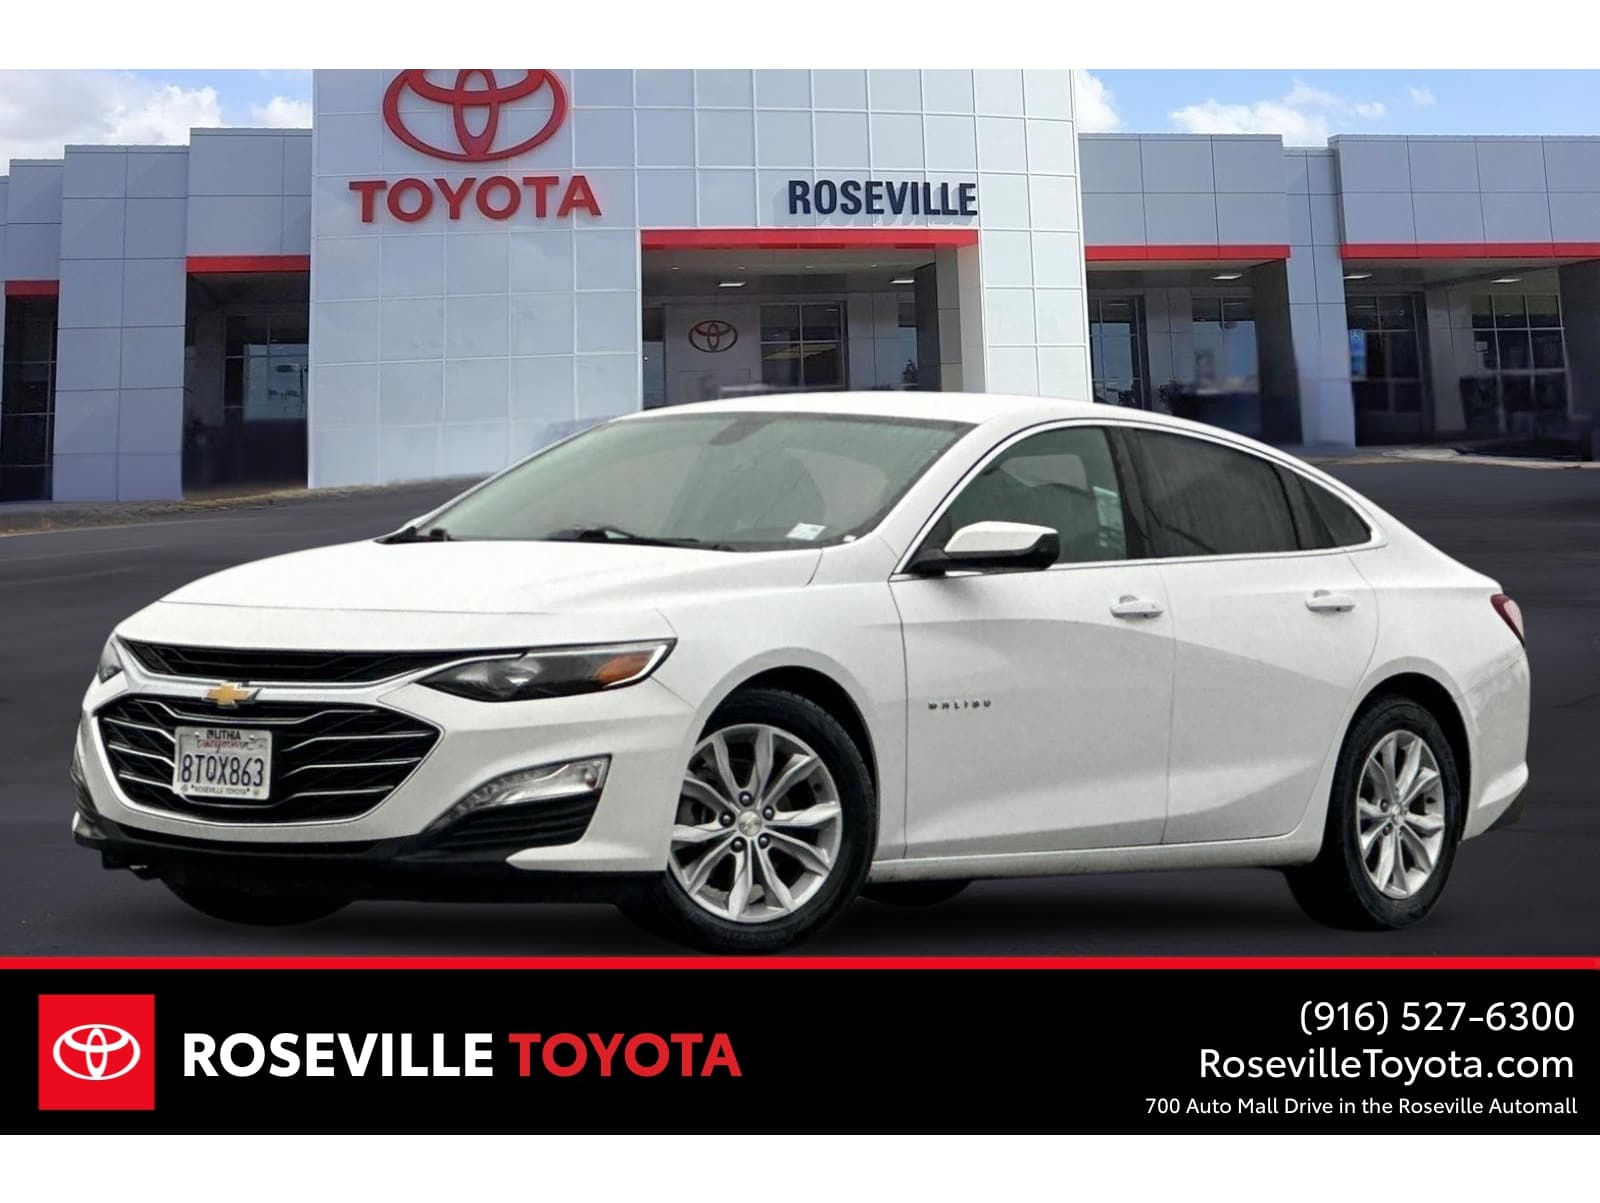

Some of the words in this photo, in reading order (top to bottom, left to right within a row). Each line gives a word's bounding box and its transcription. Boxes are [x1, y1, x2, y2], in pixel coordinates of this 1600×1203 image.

[349, 175, 602, 223] TOYOTA
[788, 179, 978, 217] ROSEVILLE
[214, 729, 241, 740] LITHIA
